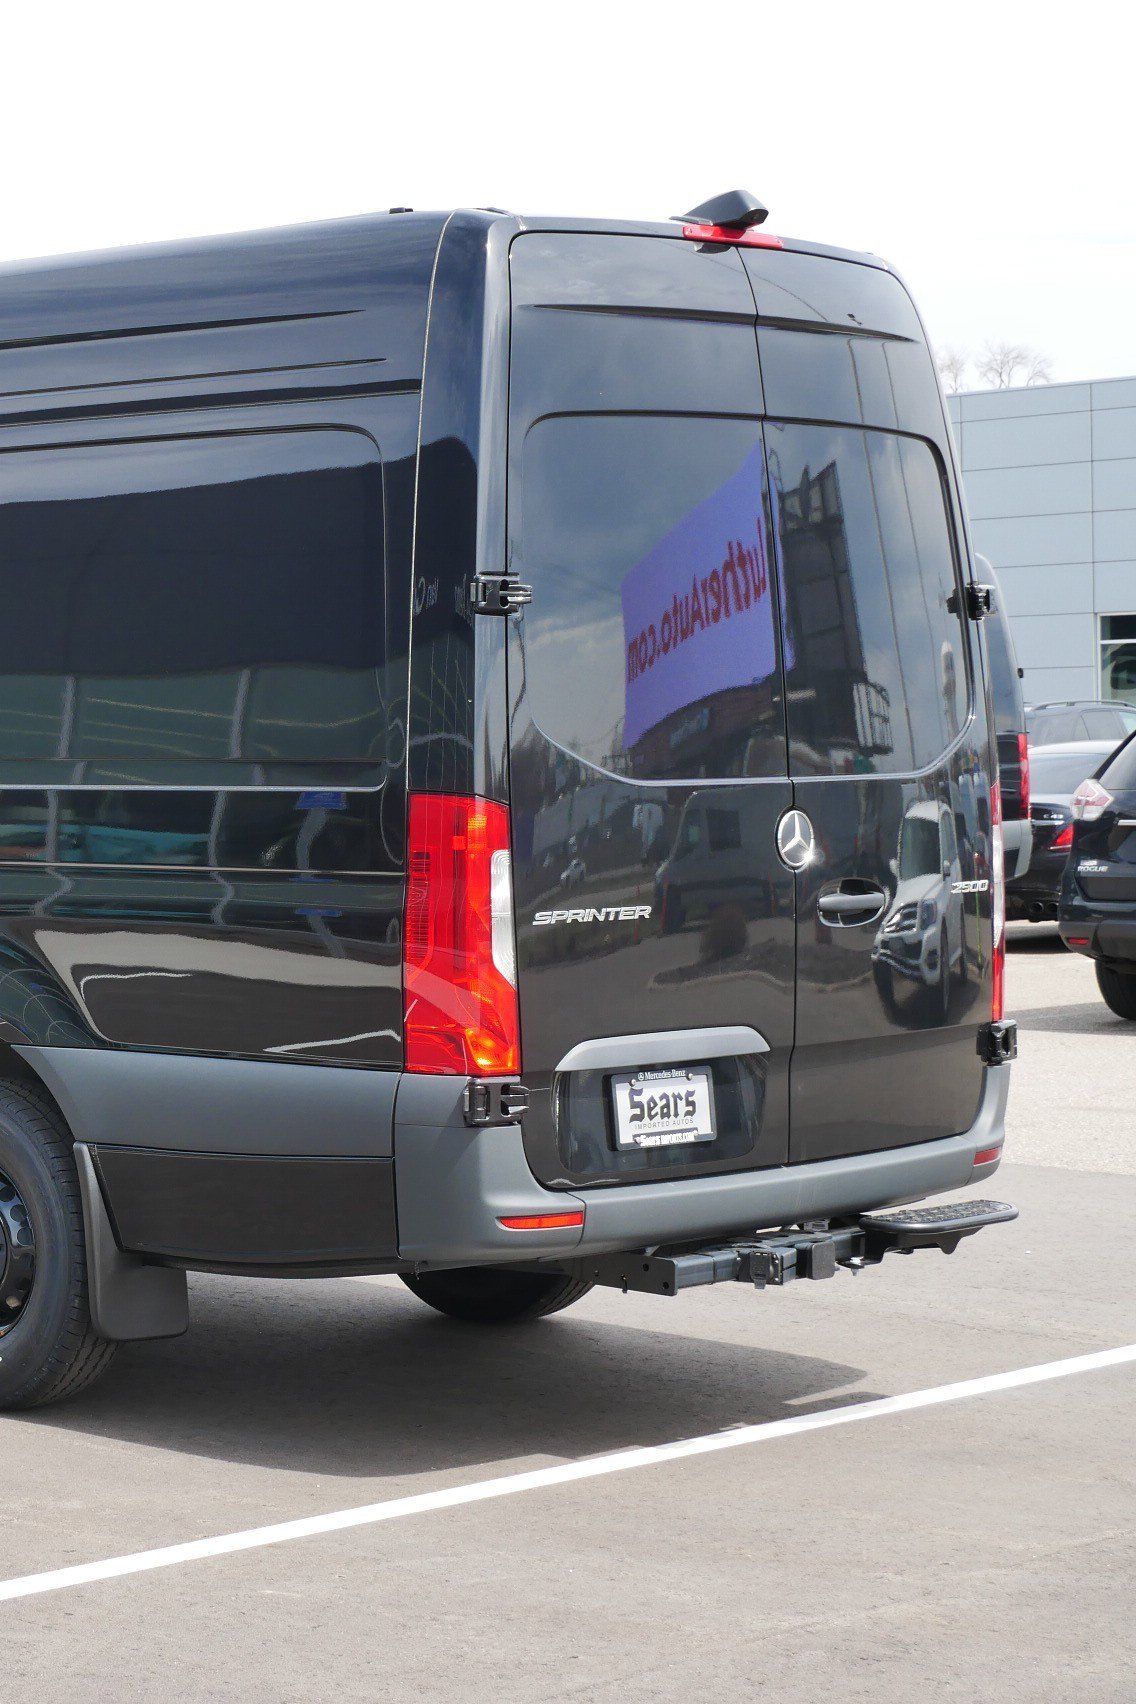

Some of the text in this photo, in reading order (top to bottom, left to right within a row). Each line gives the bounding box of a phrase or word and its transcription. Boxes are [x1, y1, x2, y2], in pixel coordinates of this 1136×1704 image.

[950, 879, 989, 894] 2500
[532, 905, 652, 926] SPRINTER
[644, 1069, 686, 1080] Mercedes-Benz
[628, 1087, 697, 1123] Sears
[634, 1118, 694, 1130] IMPORTED AUTOS
